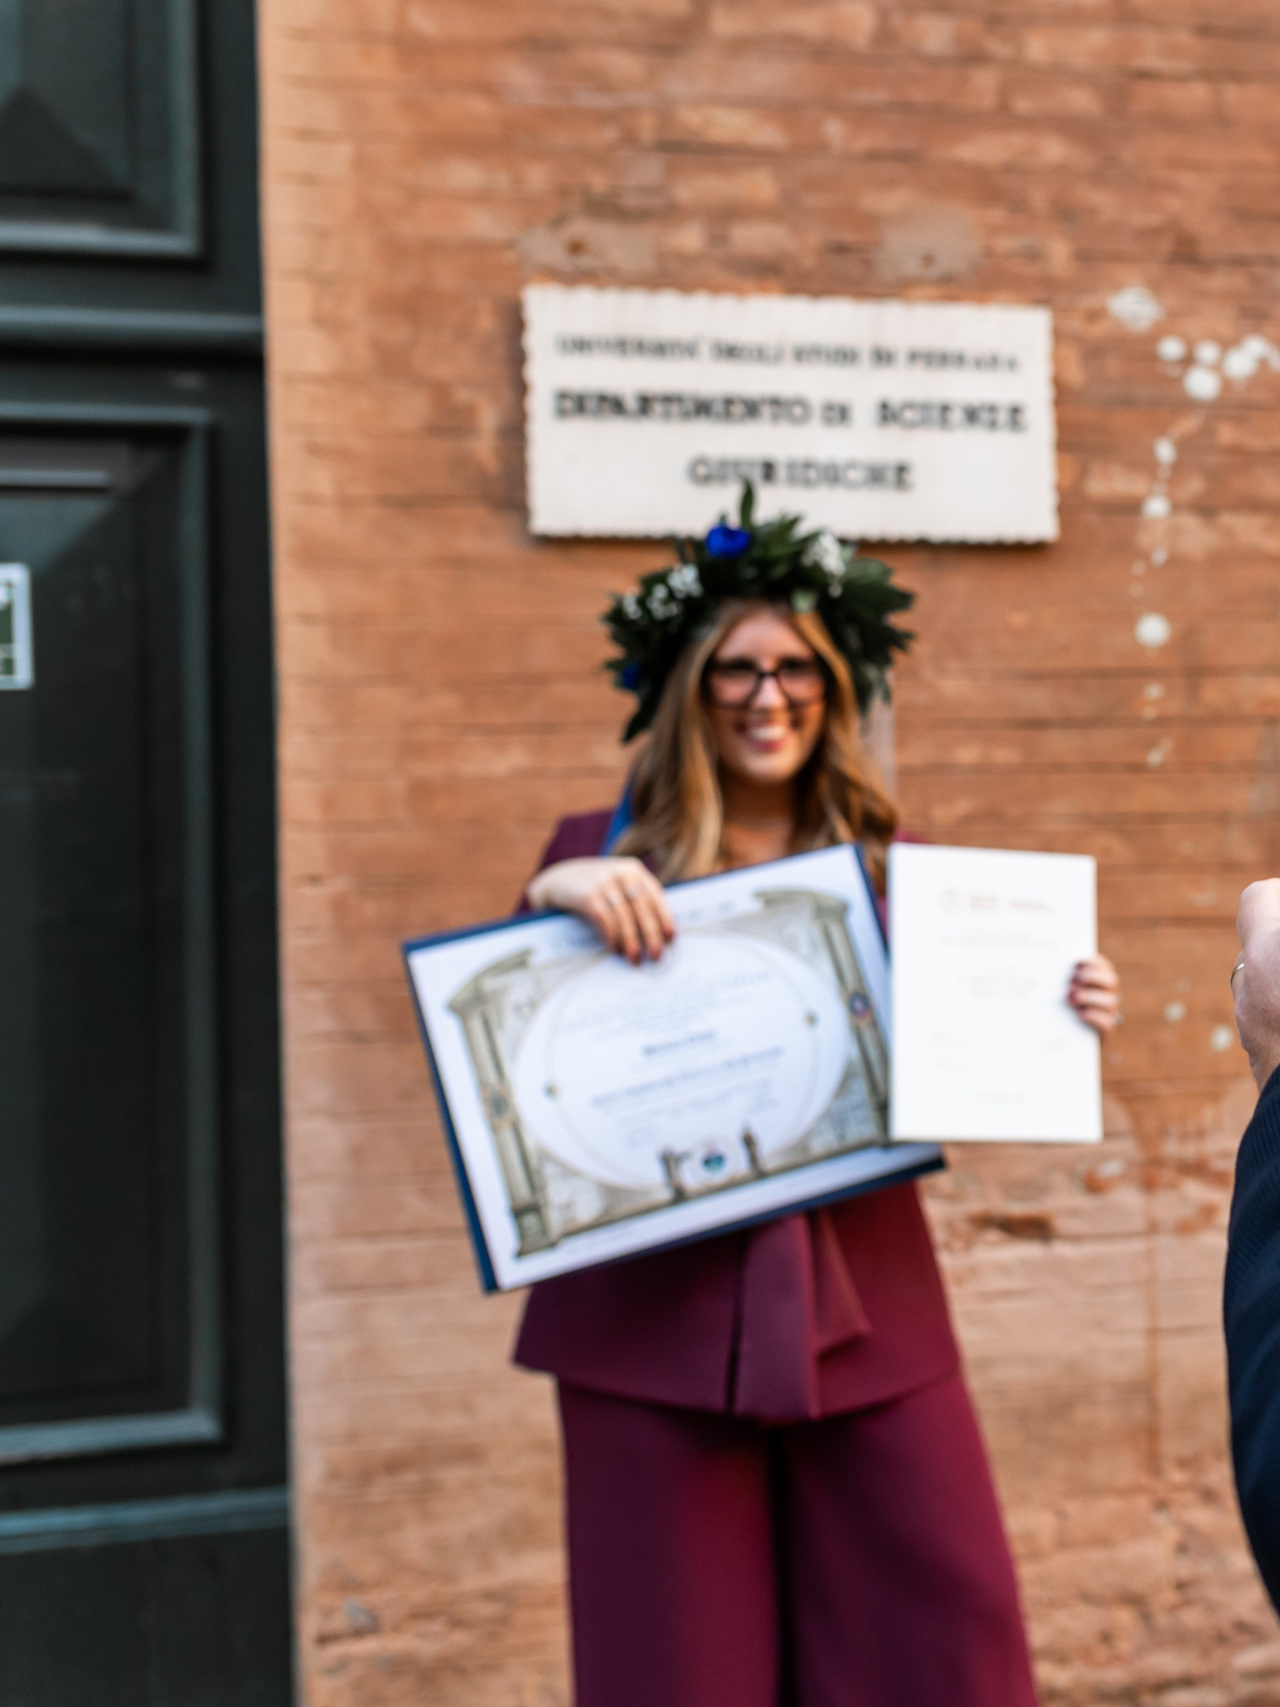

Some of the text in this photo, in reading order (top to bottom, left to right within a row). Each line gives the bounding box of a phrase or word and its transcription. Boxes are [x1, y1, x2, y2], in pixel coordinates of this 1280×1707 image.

[907, 348, 1020, 372] FERRARA
[554, 389, 1028, 432] DIPARTIMENTO DI SCIENZE
[688, 457, 914, 490] GIURIDICHE
